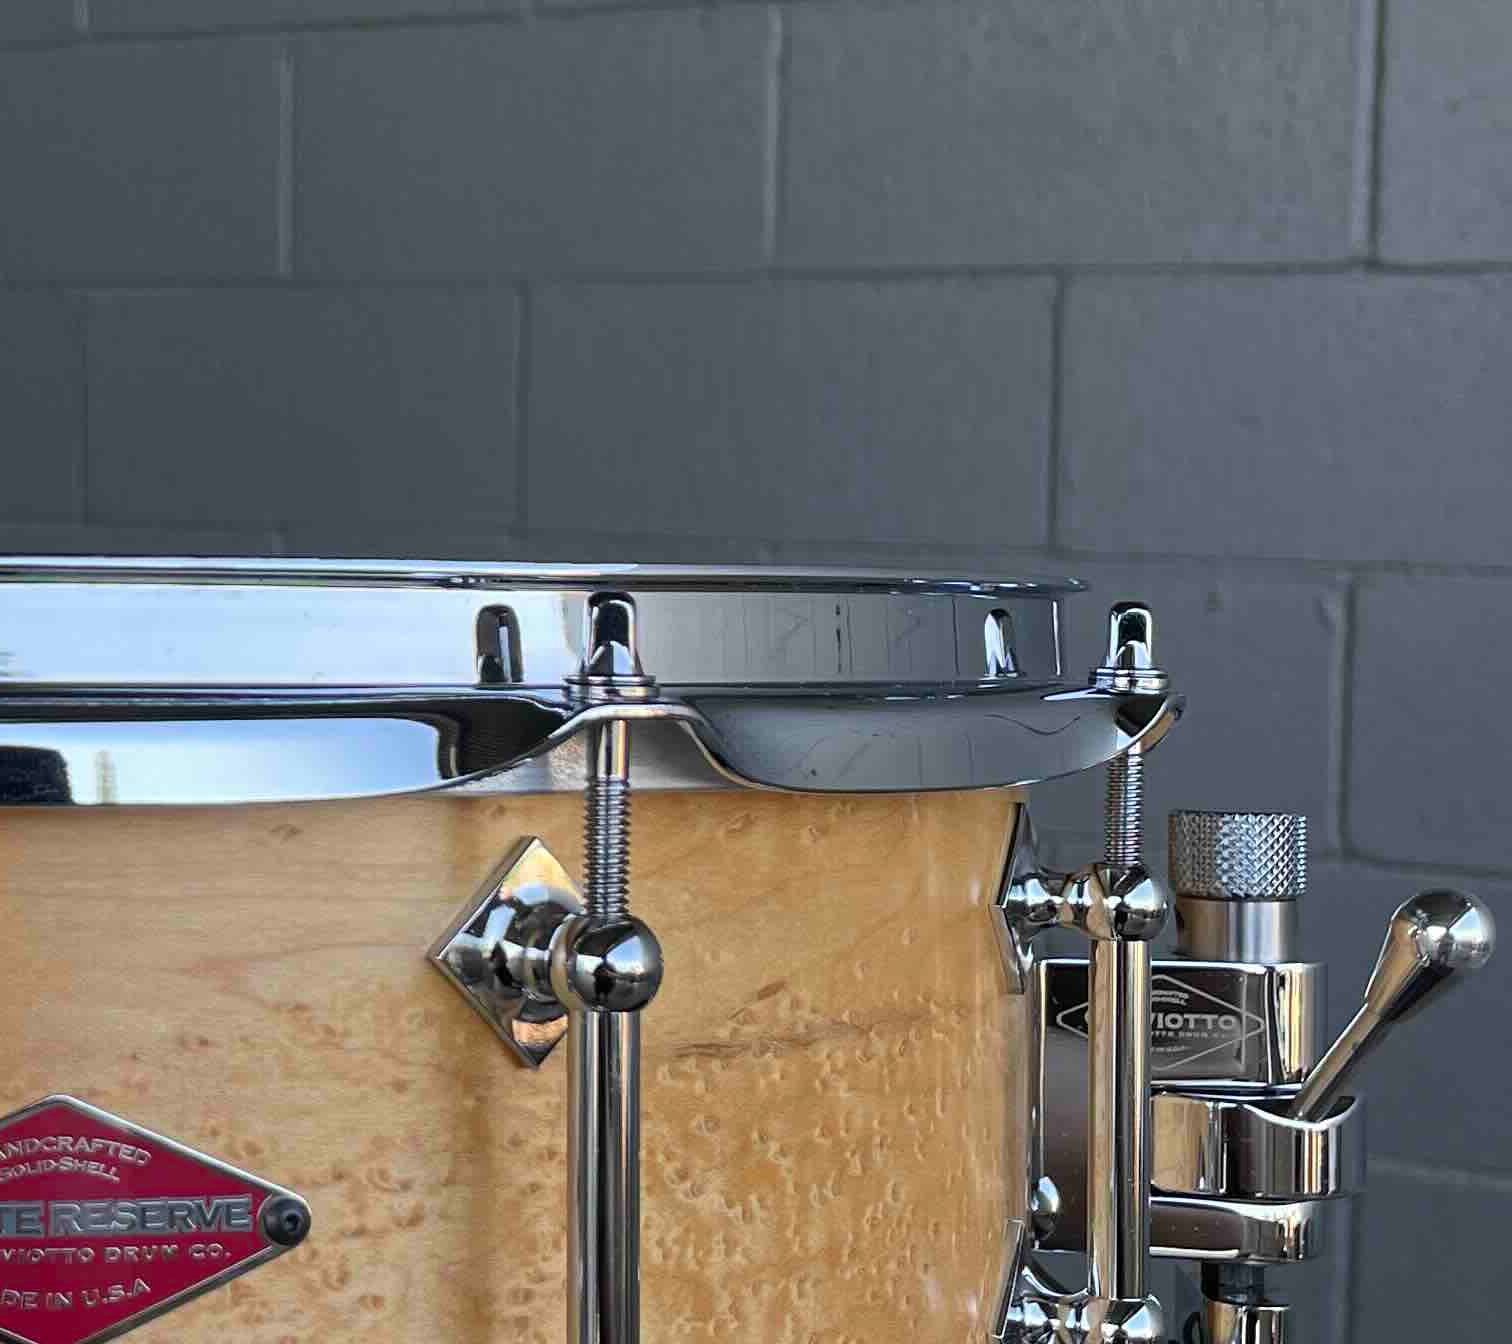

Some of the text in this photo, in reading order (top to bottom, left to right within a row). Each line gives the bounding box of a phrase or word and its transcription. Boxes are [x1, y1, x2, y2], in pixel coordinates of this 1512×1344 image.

[50, 1194, 254, 1237] RESERVE
[103, 1243, 179, 1265] DRUM
[190, 1241, 232, 1260] CO.
[46, 1291, 74, 1310] IN
